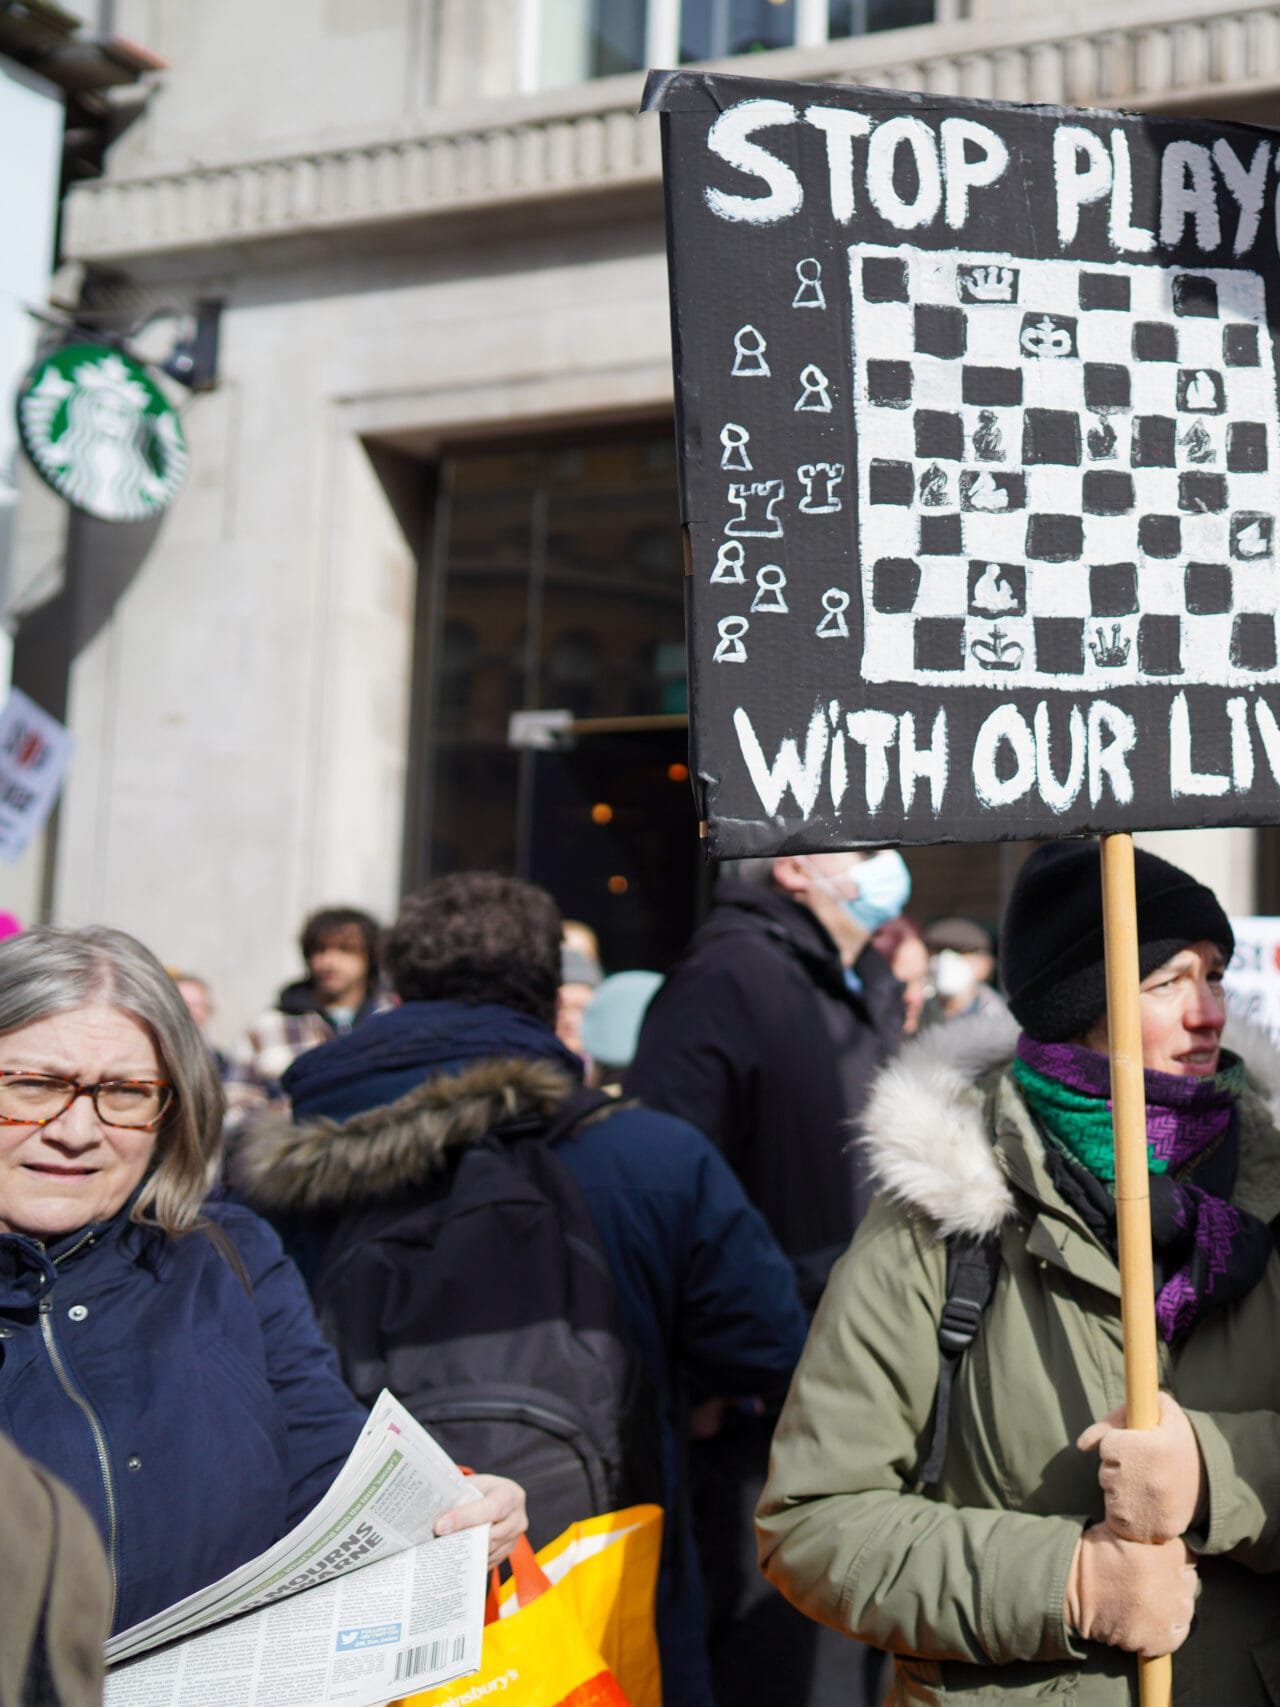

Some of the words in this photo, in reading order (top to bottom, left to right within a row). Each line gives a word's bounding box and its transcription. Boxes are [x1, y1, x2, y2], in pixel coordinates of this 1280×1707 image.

[706, 99, 1010, 230] STOP
[972, 699, 1136, 815] OUR
[264, 1521, 374, 1598] MOURNS
[333, 1514, 351, 1534] with
[349, 1503, 361, 1517] the
